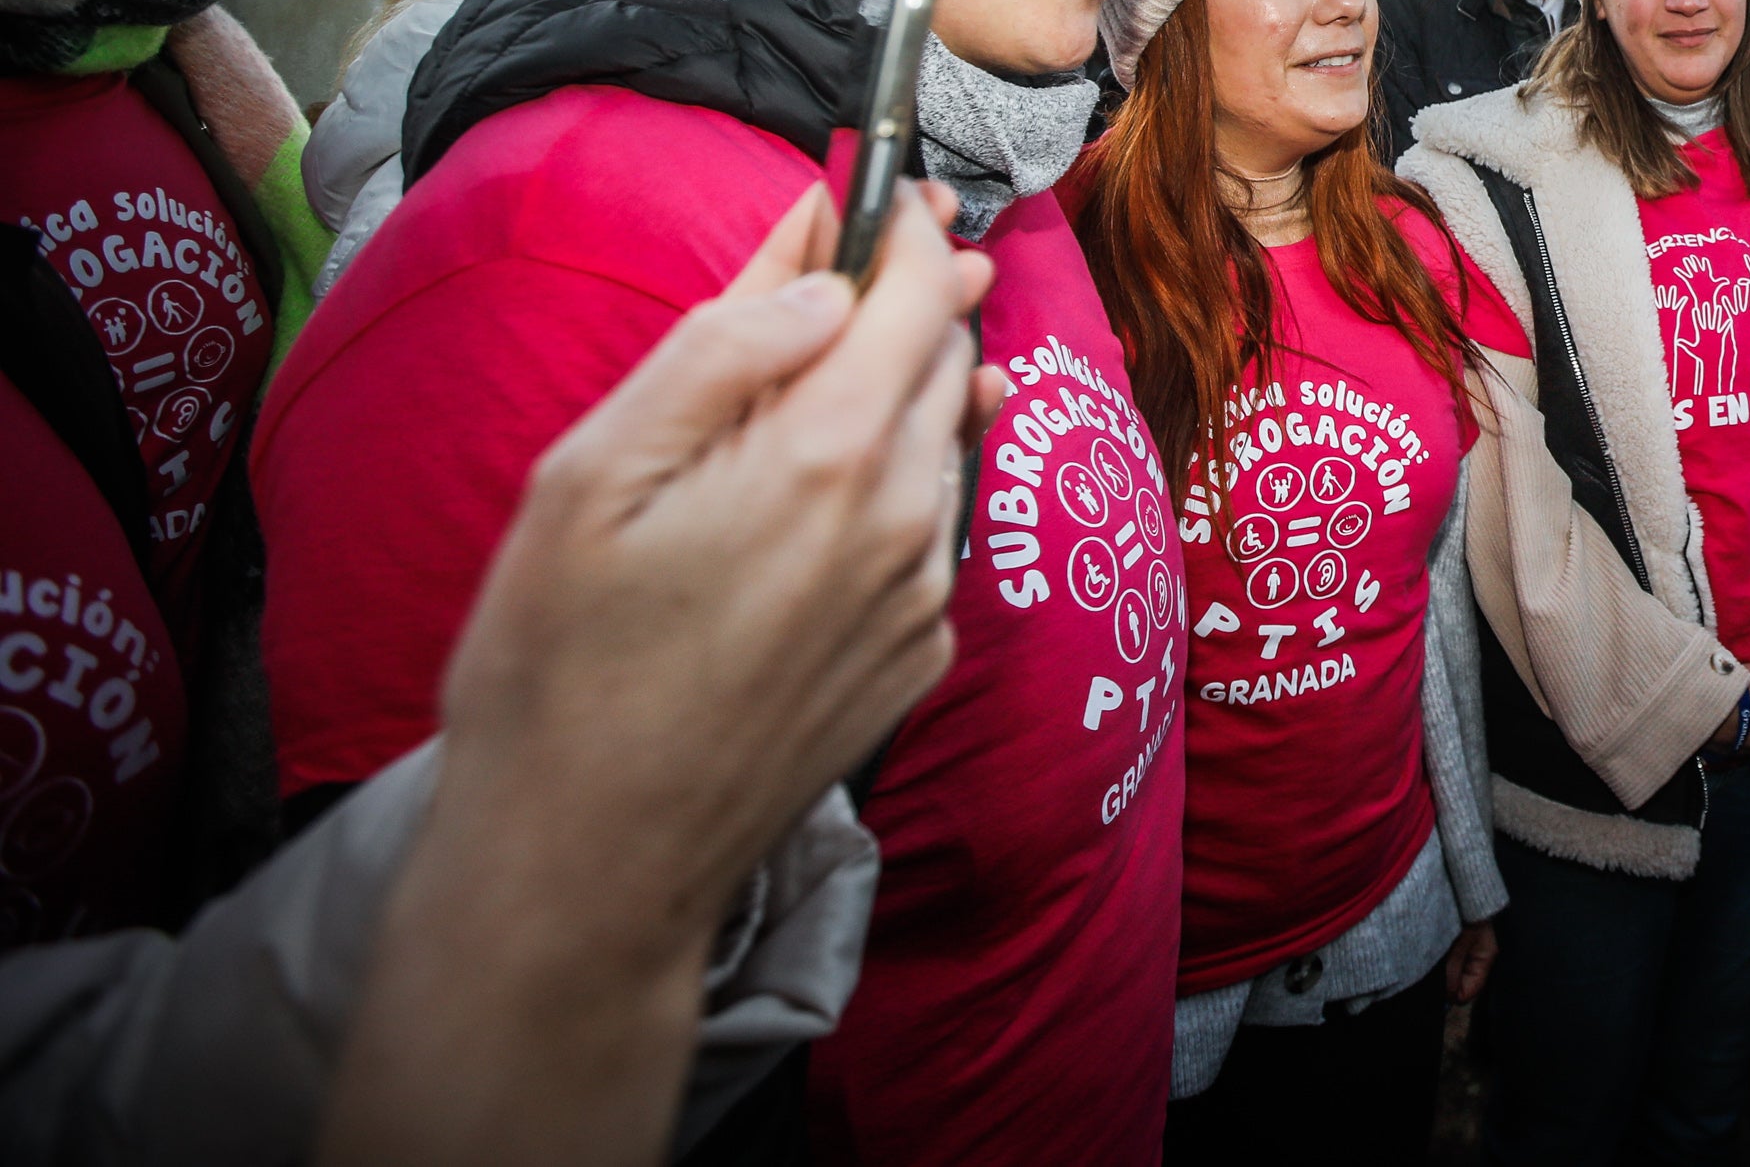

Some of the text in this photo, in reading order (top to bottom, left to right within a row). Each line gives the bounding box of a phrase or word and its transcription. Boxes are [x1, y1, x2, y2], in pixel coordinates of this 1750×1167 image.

[64, 231, 264, 336] OGACIÓN
[1222, 380, 1430, 465] nica solución:
[1708, 392, 1749, 426] EN
[987, 386, 1164, 609] SUBROGACIÓN
[1200, 653, 1356, 705] GRANADA
